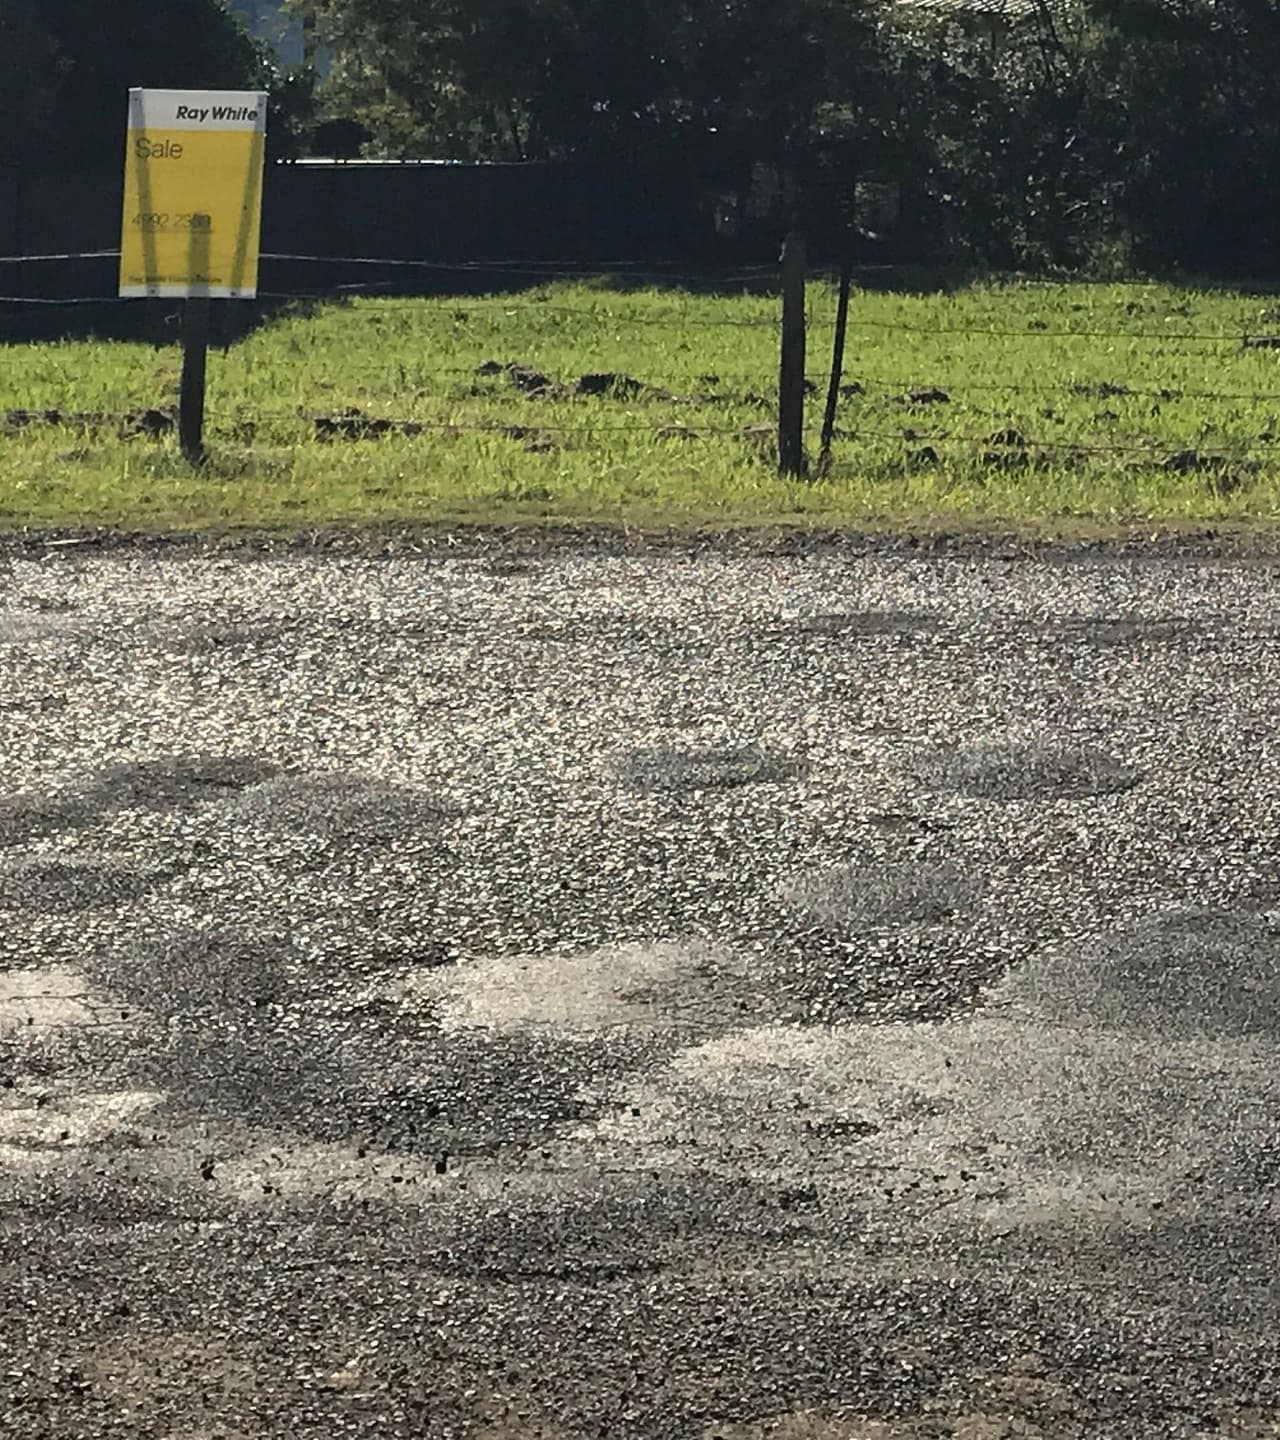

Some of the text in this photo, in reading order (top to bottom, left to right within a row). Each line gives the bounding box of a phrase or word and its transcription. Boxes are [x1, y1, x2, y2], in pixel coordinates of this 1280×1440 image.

[175, 105, 259, 124] Ray White
[135, 137, 184, 160] Sale
